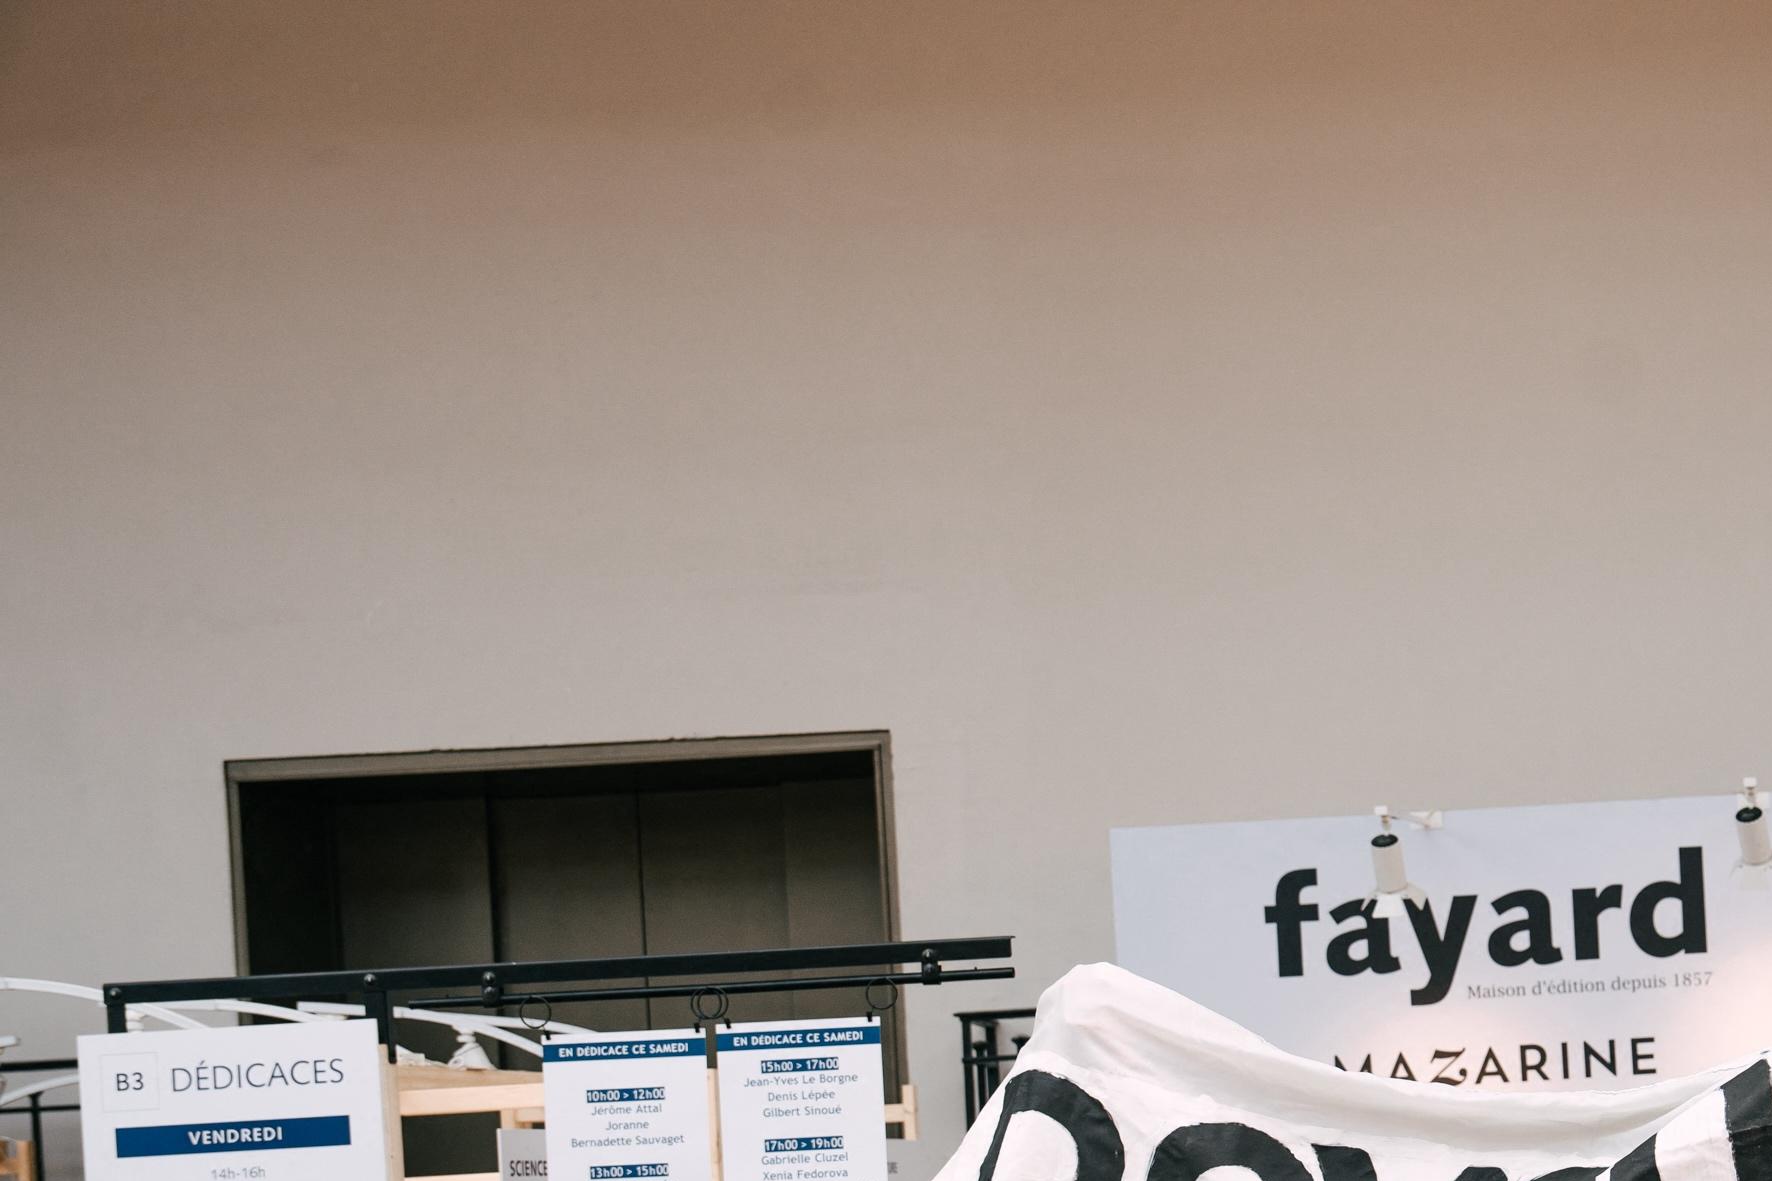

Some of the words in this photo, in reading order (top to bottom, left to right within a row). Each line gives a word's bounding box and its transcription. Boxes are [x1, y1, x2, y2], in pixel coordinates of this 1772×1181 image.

[1264, 846, 1708, 1006] fayard
[1468, 983, 1526, 999] Maison
[1532, 980, 1605, 996] d'édition
[1611, 975, 1666, 992] depuis
[1673, 972, 1713, 987] 1857
[733, 1037, 748, 1046] EN
[751, 1032, 803, 1046] DÉDICACE
[806, 1034, 819, 1043] CE
[824, 1031, 863, 1042] SAMEDI
[559, 1048, 573, 1057] EN
[577, 1045, 628, 1057] DÉDICACE
[632, 1045, 645, 1054] CE
[649, 1043, 688, 1053] SAMEDI
[761, 1061, 793, 1072] 15h00
[806, 1058, 839, 1069] 17h00
[115, 1072, 144, 1091] B3
[171, 1058, 344, 1093] DÉDICACES
[744, 1076, 799, 1087] Jean-Yves
[802, 1075, 816, 1084] Le
[820, 1073, 858, 1085] Borgne
[587, 1090, 620, 1101] 10h00
[633, 1088, 665, 1099] 12h00
[768, 1091, 797, 1102] Denis
[636, 1104, 662, 1113] Attal
[763, 1107, 800, 1117] Gilbert
[804, 1105, 842, 1115] Sinoué
[605, 1121, 649, 1131] Joranne
[188, 1127, 283, 1145] VENDREDI
[571, 1138, 632, 1148] Bernadette
[636, 1135, 684, 1147] Sauvaget
[765, 1140, 798, 1151] 17h00
[811, 1137, 844, 1148] 19h00
[761, 1154, 811, 1165] Gabrielle
[815, 1153, 849, 1163] Cluzel
[211, 1167, 266, 1179] 14h-16h
[591, 1167, 623, 1178] 13h00
[637, 1164, 669, 1176] 15h00
[763, 1171, 793, 1181] Xenia
[797, 1169, 849, 1179] Fedorova
